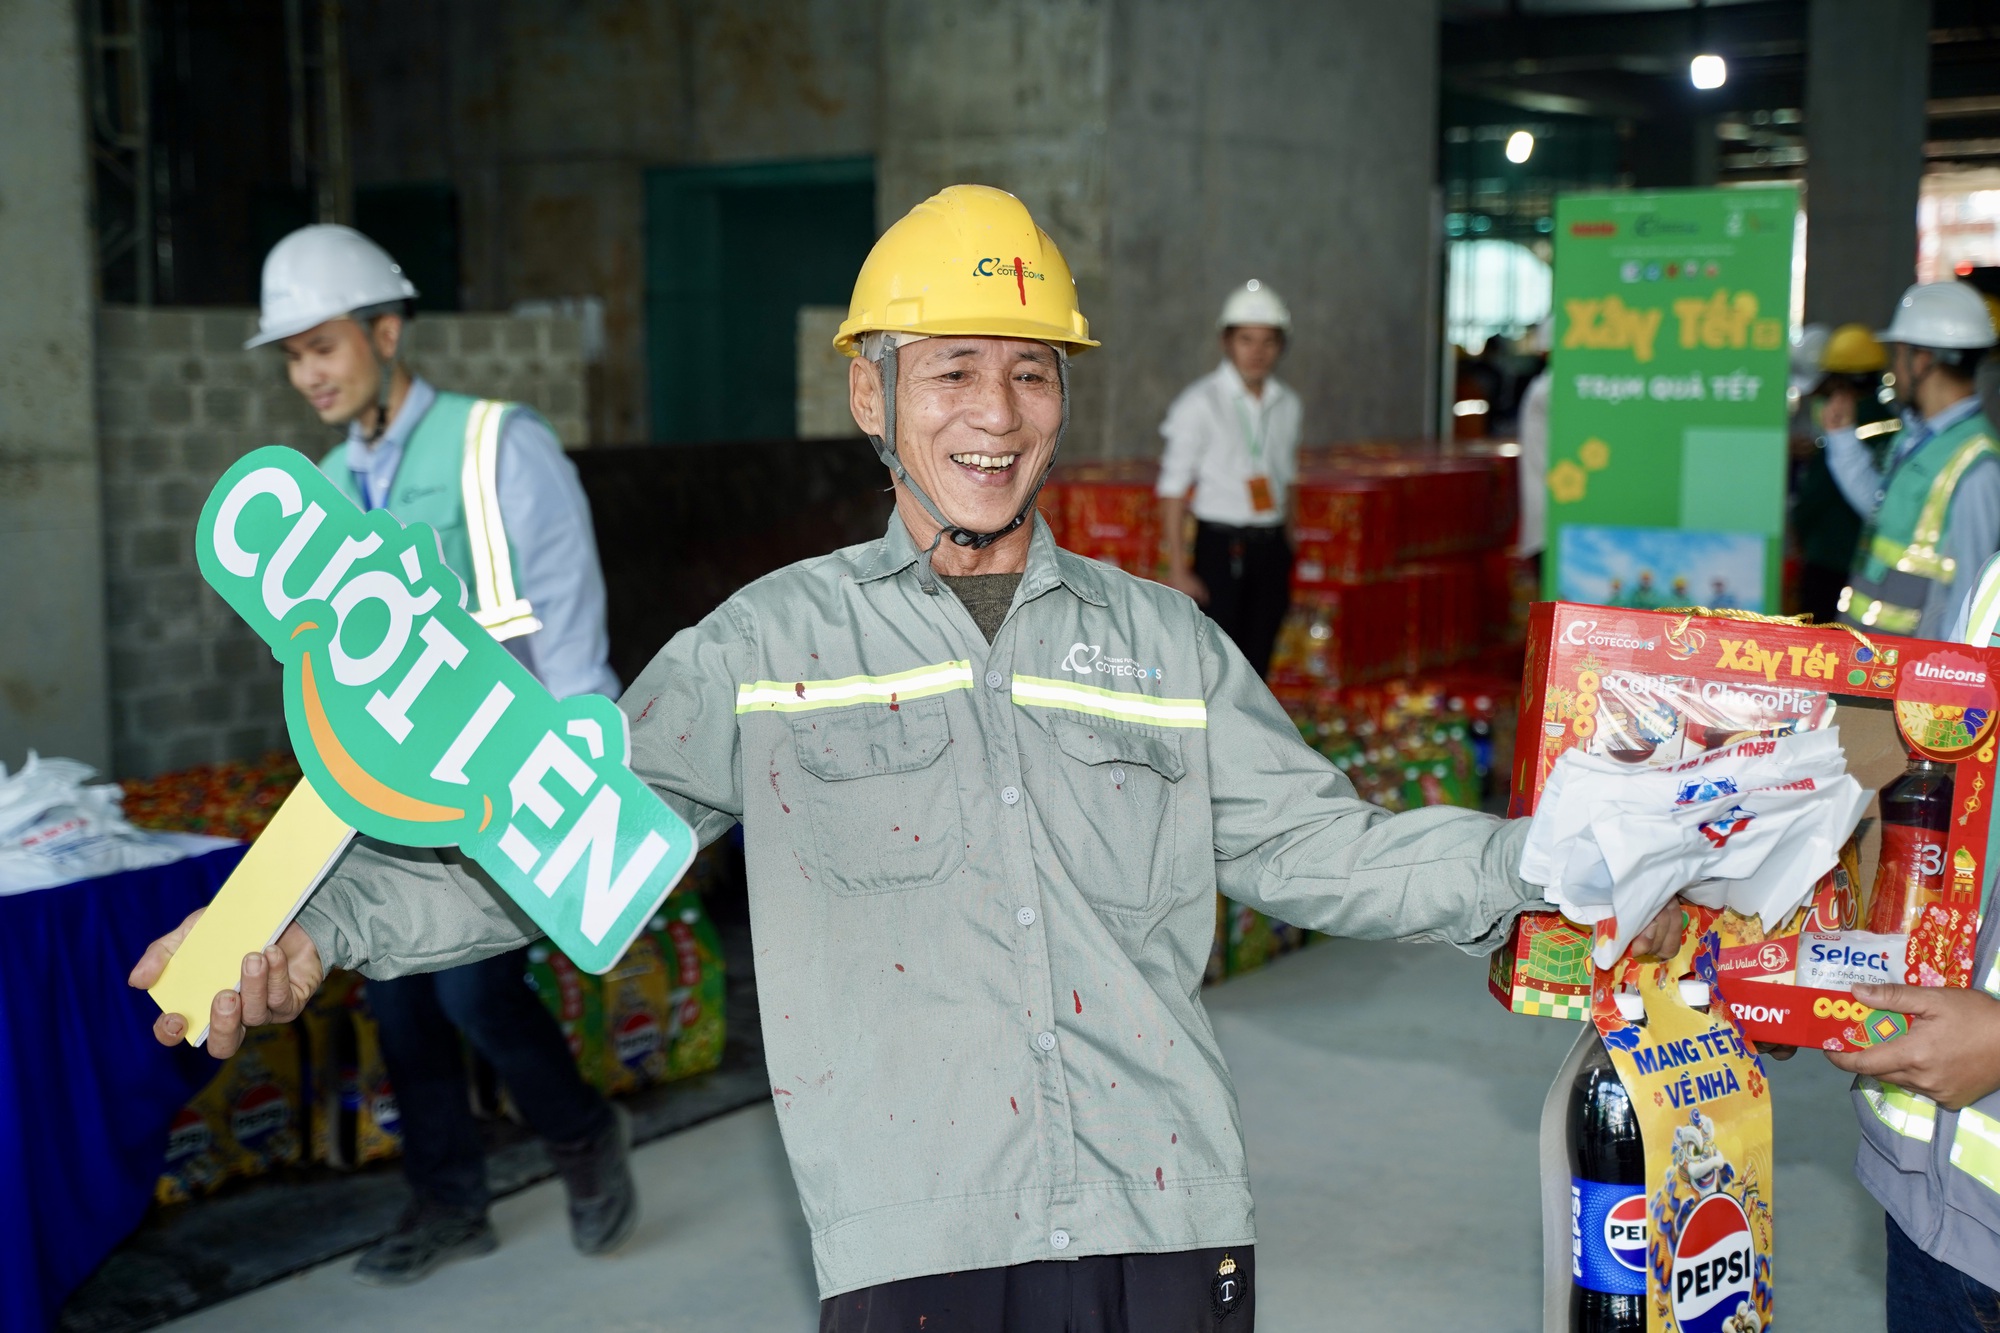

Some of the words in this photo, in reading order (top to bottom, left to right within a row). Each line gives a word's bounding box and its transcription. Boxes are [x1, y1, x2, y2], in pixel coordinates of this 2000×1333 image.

[997, 268, 1045, 281] COTECONS
[1564, 294, 1662, 363] Xây
[1096, 661, 1162, 680] COTECCONS
[1715, 638, 1784, 682] Xây
[1788, 643, 1840, 680] Tết
[1915, 662, 1986, 683] Unicons
[213, 467, 469, 744] CƯỜI
[430, 680, 671, 947] LÊN
[1702, 683, 1812, 714] ChocoPie
[1735, 957, 1759, 969] Value
[1810, 944, 1889, 972] Select
[1631, 1037, 1701, 1076] MANG
[1695, 1022, 1739, 1058] TẾT
[1663, 1070, 1696, 1109] VỀ
[1695, 1062, 1741, 1102] NHÀ
[1571, 1185, 1582, 1278] PEPSI
[1676, 1246, 1751, 1303] PEPSI
